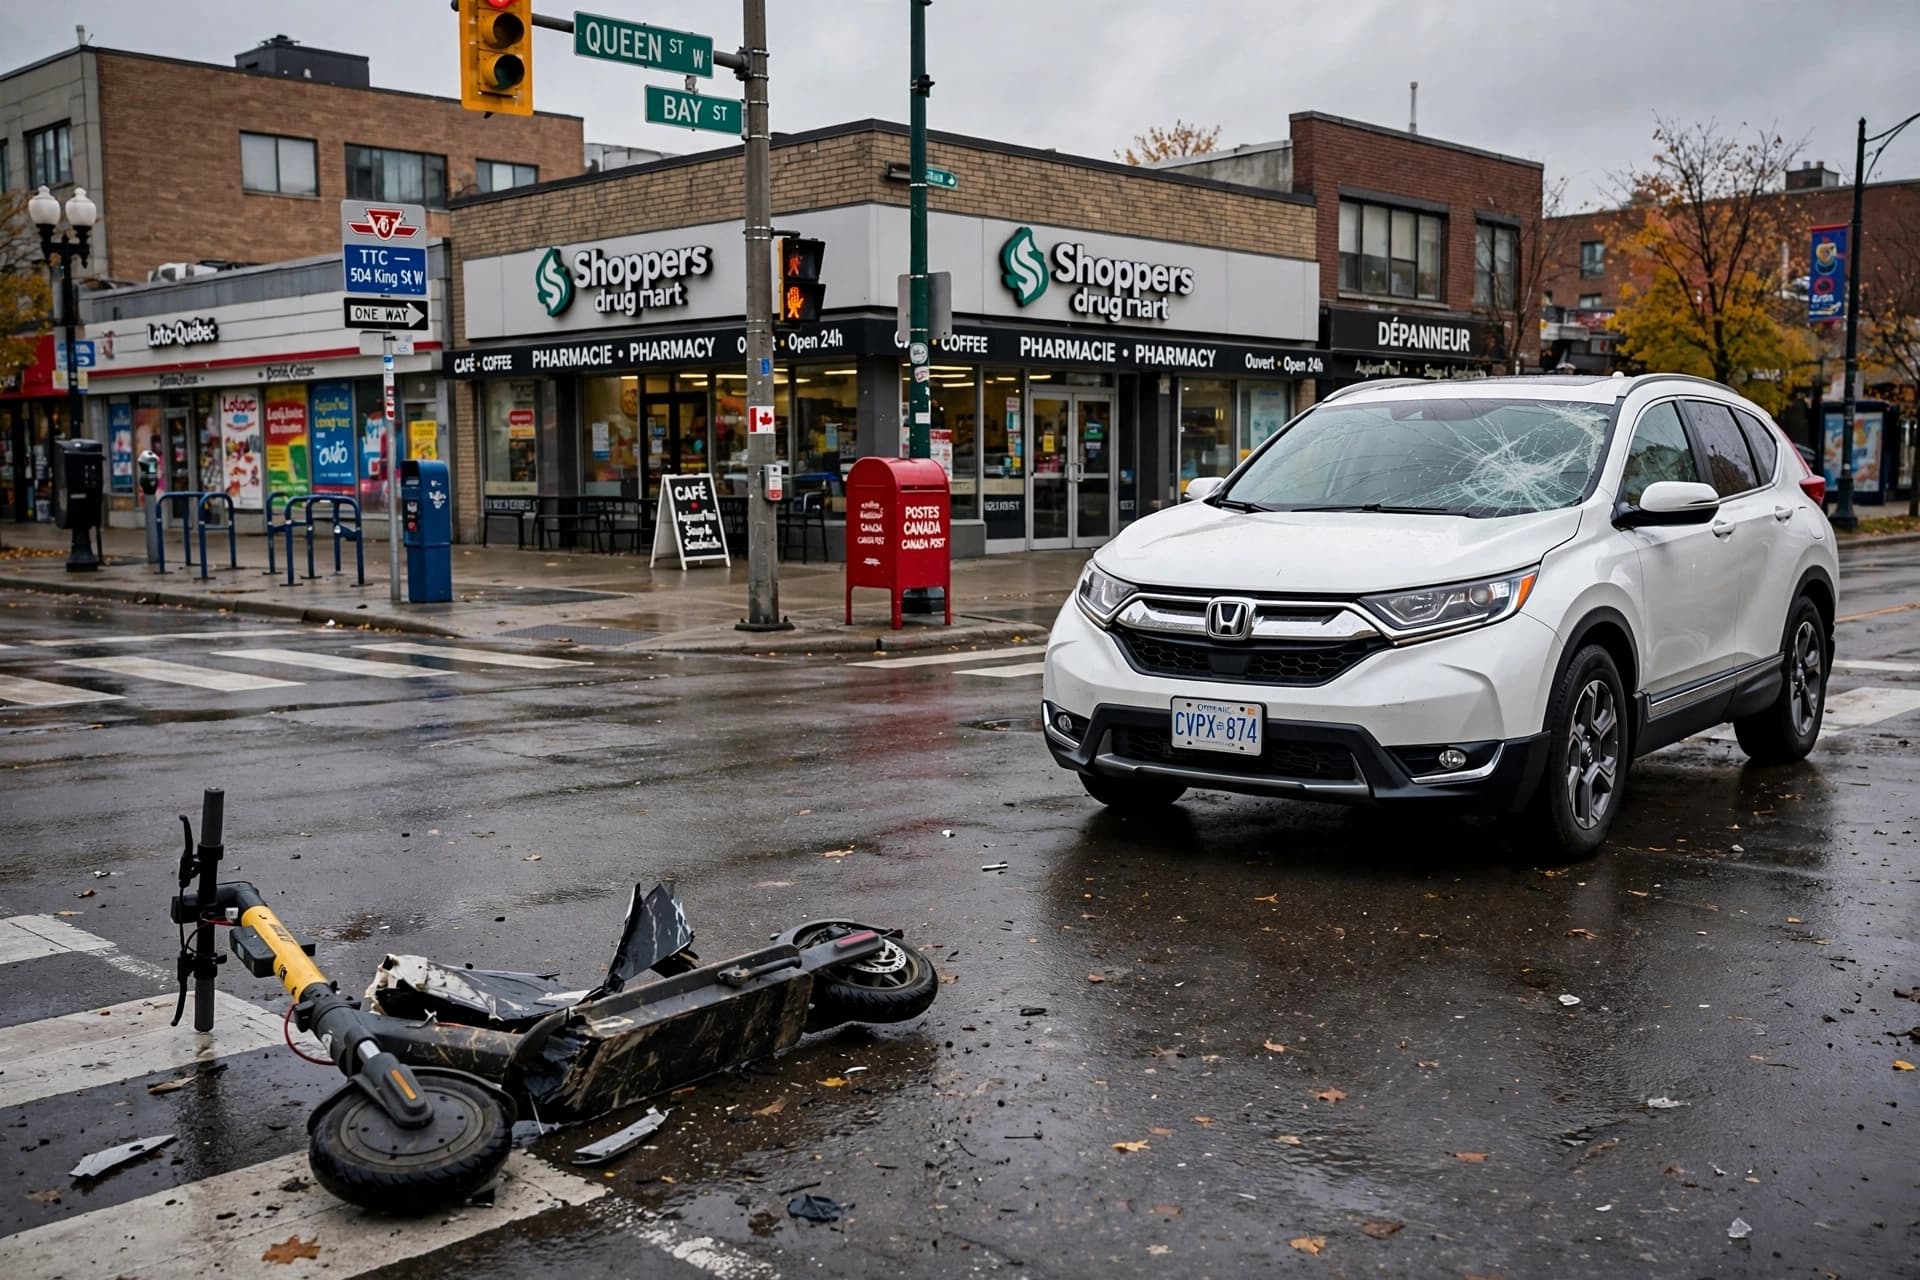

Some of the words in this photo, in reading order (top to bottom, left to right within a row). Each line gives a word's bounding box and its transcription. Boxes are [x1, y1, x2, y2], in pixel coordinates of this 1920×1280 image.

[586, 22, 662, 62] QUEEN
[669, 39, 684, 55] ST
[693, 49, 704, 68] W
[664, 95, 702, 123] BAY
[713, 105, 728, 121] ST
[360, 250, 388, 265] TTC
[574, 246, 707, 291] Shoppers
[1055, 242, 1194, 298] Shoppers
[351, 268, 371, 282] 504
[375, 269, 398, 287] King
[401, 270, 412, 285] St
[413, 271, 423, 285] W
[355, 307, 379, 320] ONE
[386, 309, 408, 321] WAY
[595, 288, 635, 316] drug
[1074, 287, 1122, 321] drug
[147, 319, 216, 346] Loto-Québec
[788, 333, 818, 353] Open
[820, 328, 843, 347] 24h
[941, 334, 988, 353] COFFEE
[1378, 316, 1470, 351] DÉPANNEUR
[454, 353, 475, 373] CAFÉ
[482, 355, 512, 371] COFFEE
[532, 345, 613, 368] PHARMACIE
[630, 337, 715, 362] PHARMACY
[1020, 336, 1116, 362] PHARMACIE
[1135, 344, 1216, 368] PHARMACY
[1245, 353, 1275, 370] Ouvert
[1284, 356, 1306, 374] Open
[1307, 357, 1324, 372] 24h
[674, 481, 708, 501] CAFÉ
[905, 506, 940, 519] POSTES
[904, 520, 941, 535] CANADA
[1175, 711, 1216, 738] CVPX
[1226, 717, 1257, 743] 874
